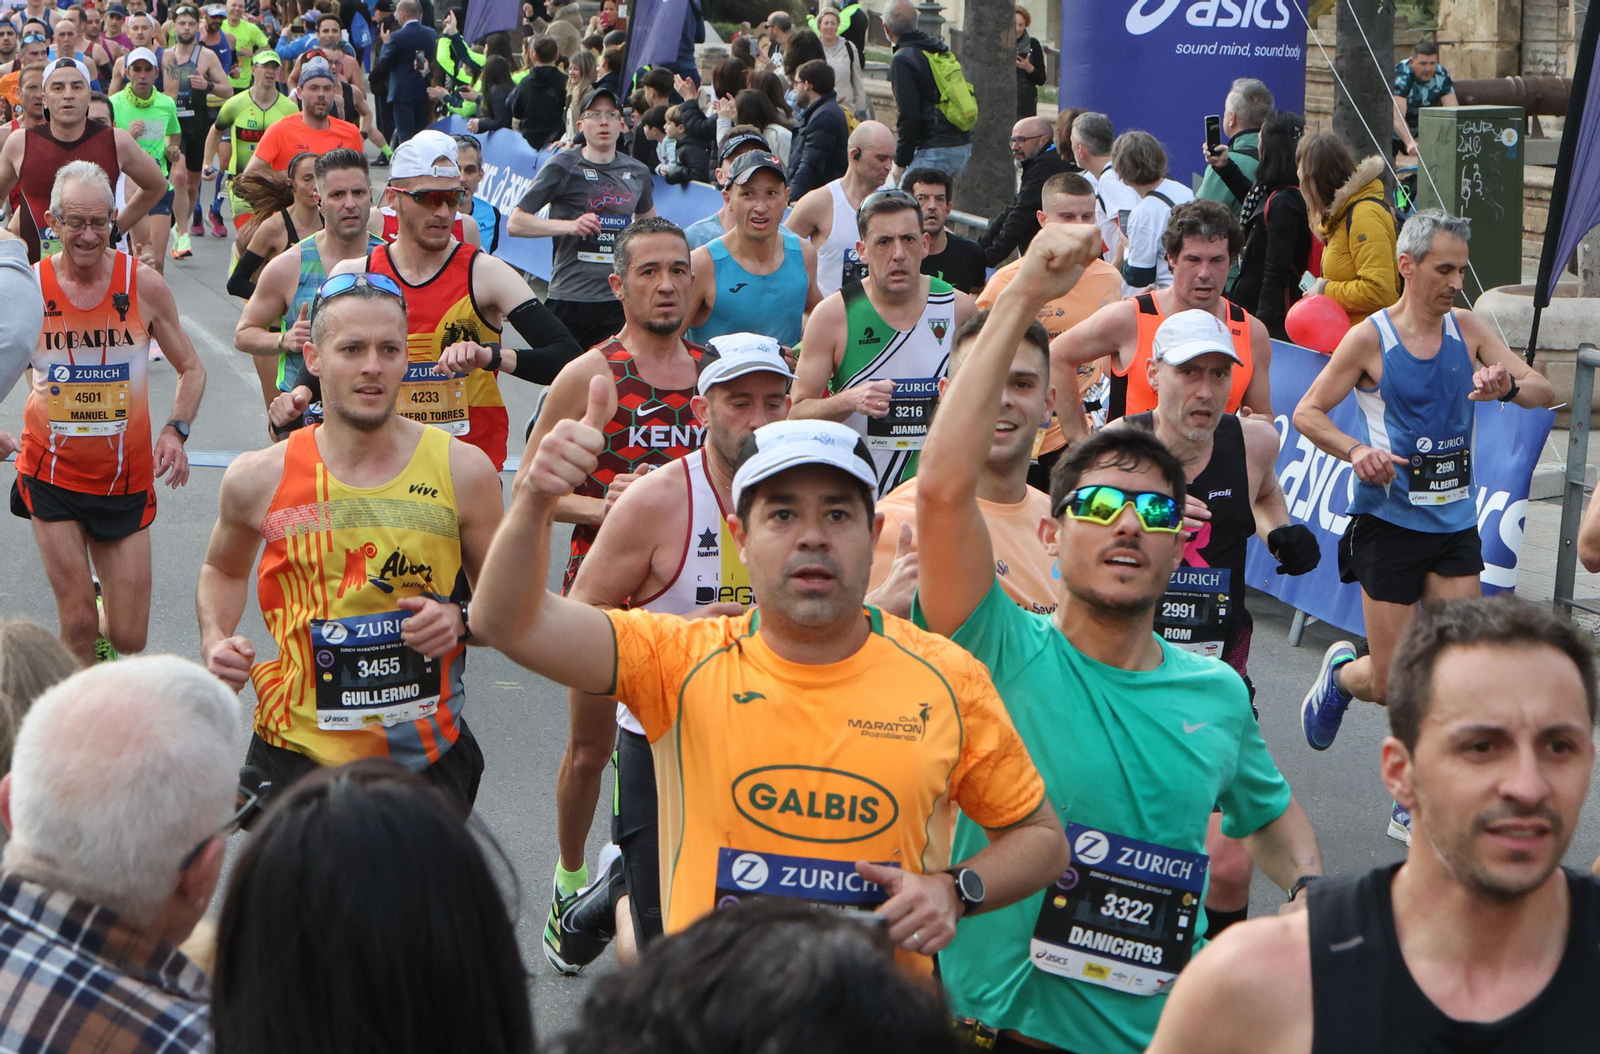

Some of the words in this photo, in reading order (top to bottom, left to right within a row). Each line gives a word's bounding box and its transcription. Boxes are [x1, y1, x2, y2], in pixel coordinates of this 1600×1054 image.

[1175, 41, 1218, 55] sound
[1219, 42, 1252, 57] mind,
[1253, 44, 1284, 58] sound
[1284, 45, 1301, 61] body
[599, 217, 626, 226] ZURICH
[597, 232, 615, 242] 2534
[599, 245, 612, 253] ROB
[43, 328, 135, 350] TOBARRA
[75, 368, 120, 379] ZURICH
[410, 367, 455, 378] ZUR
[896, 382, 940, 393] ZURICH
[75, 392, 102, 403] 4501
[411, 391, 439, 403] 4233
[70, 411, 109, 420] MANUEL
[397, 411, 427, 421] MERO
[429, 408, 465, 421] TORRES
[895, 405, 923, 418] 3216
[889, 424, 928, 435] JUANMA
[1437, 435, 1465, 450] ZURICH
[1435, 460, 1455, 474] 2690
[1429, 477, 1459, 490] ALBERTO
[1208, 488, 1232, 500] poli
[697, 550, 719, 558] luanvi
[1169, 572, 1220, 586] ZURICH
[1032, 602, 1059, 615] Sevi
[1162, 602, 1196, 619] 2991
[355, 617, 411, 639] ZURI
[1163, 627, 1192, 641] ROM
[357, 656, 401, 678] 3455
[341, 683, 420, 706] GUILLERMO
[848, 719, 922, 734] MARATON
[861, 730, 917, 742] Pozoblanco
[748, 783, 879, 824] GALBIS
[1116, 846, 1194, 881] ZURICH
[779, 866, 879, 892] ZURICH
[1100, 893, 1154, 926] 3322
[1068, 925, 1164, 965] DANICRT93
[1045, 953, 1068, 966] asics
